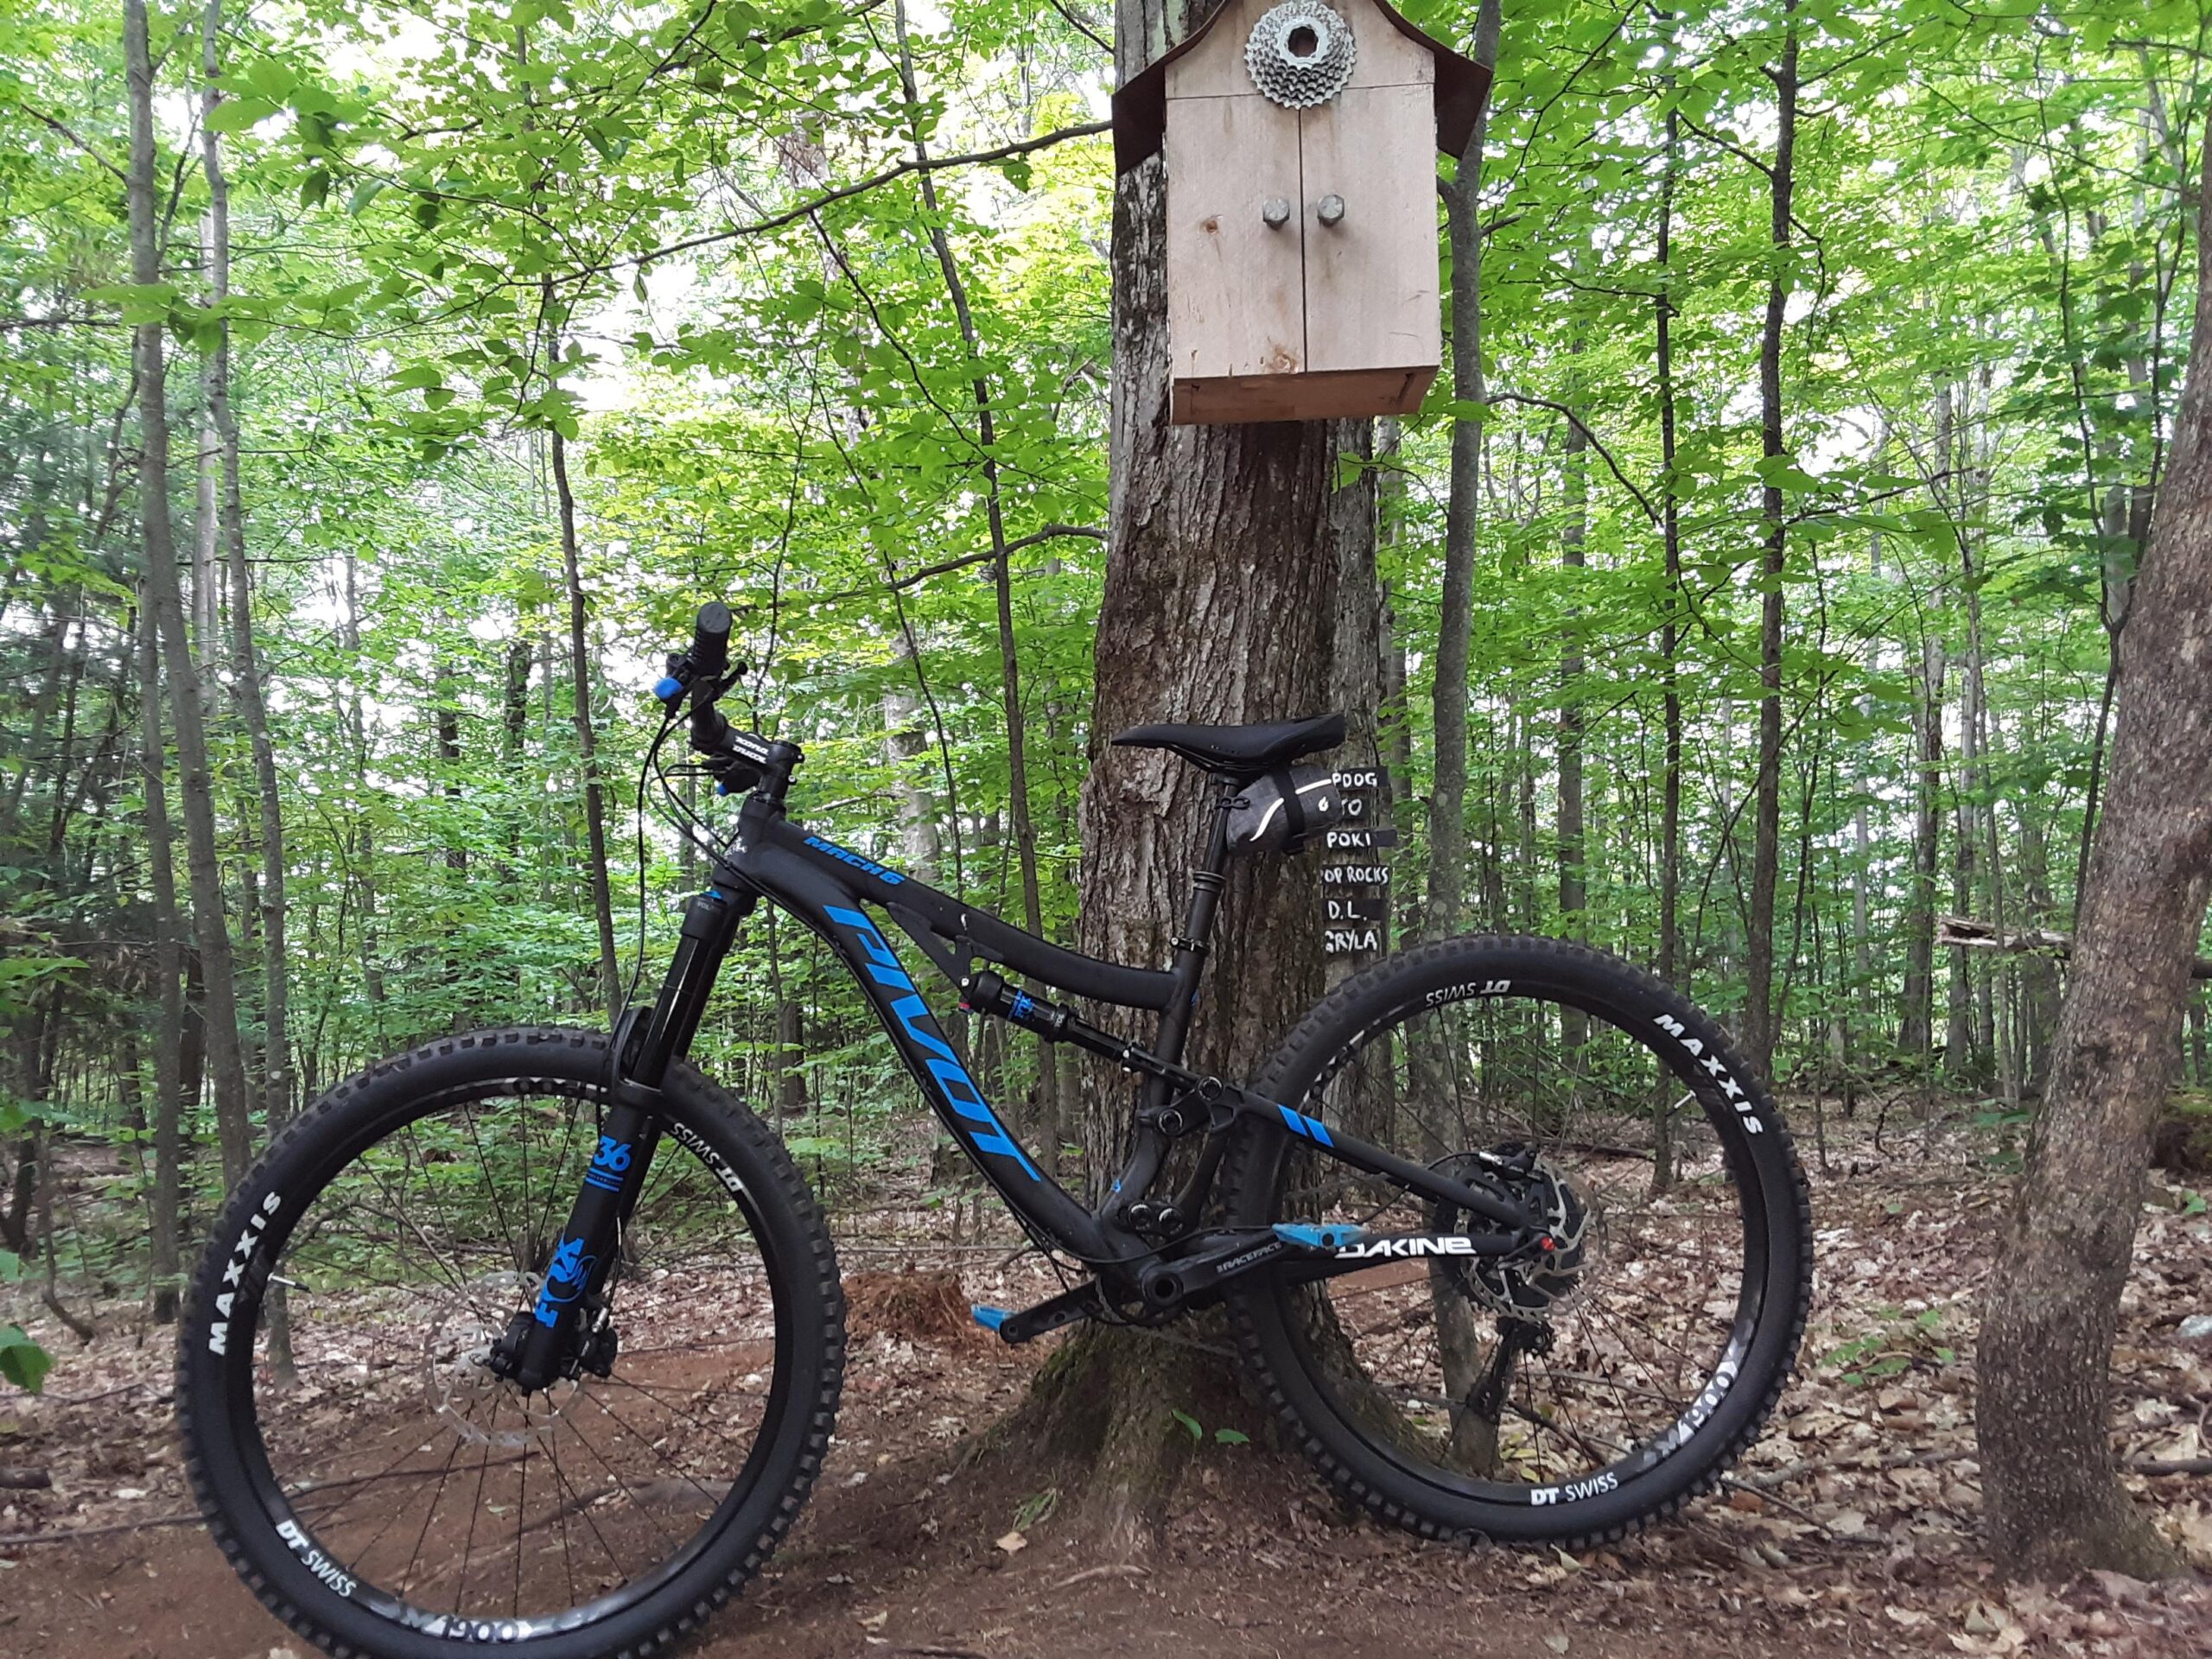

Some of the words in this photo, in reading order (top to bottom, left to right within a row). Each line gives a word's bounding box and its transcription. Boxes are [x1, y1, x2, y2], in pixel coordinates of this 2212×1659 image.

[1326, 831, 1371, 849] POKI
[804, 836, 884, 875] MACH
[879, 870, 906, 886] 6
[1346, 865, 1389, 885] ROCKS
[1425, 982, 1477, 1007] SWISS
[1479, 979, 1511, 995] DT
[823, 905, 1041, 1182] PIVOT
[1652, 1014, 1764, 1134] MAXXIS
[594, 1135, 632, 1172] 36
[671, 1122, 720, 1165] SWISS
[715, 1166, 743, 1192] DT
[208, 1192, 281, 1357] MAXXIS
[534, 1233, 598, 1328] FOX
[1530, 1487, 1560, 1506] DT
[1565, 1471, 1618, 1503] SWISS
[276, 1519, 310, 1551] DT
[302, 1549, 357, 1599] SWISS
